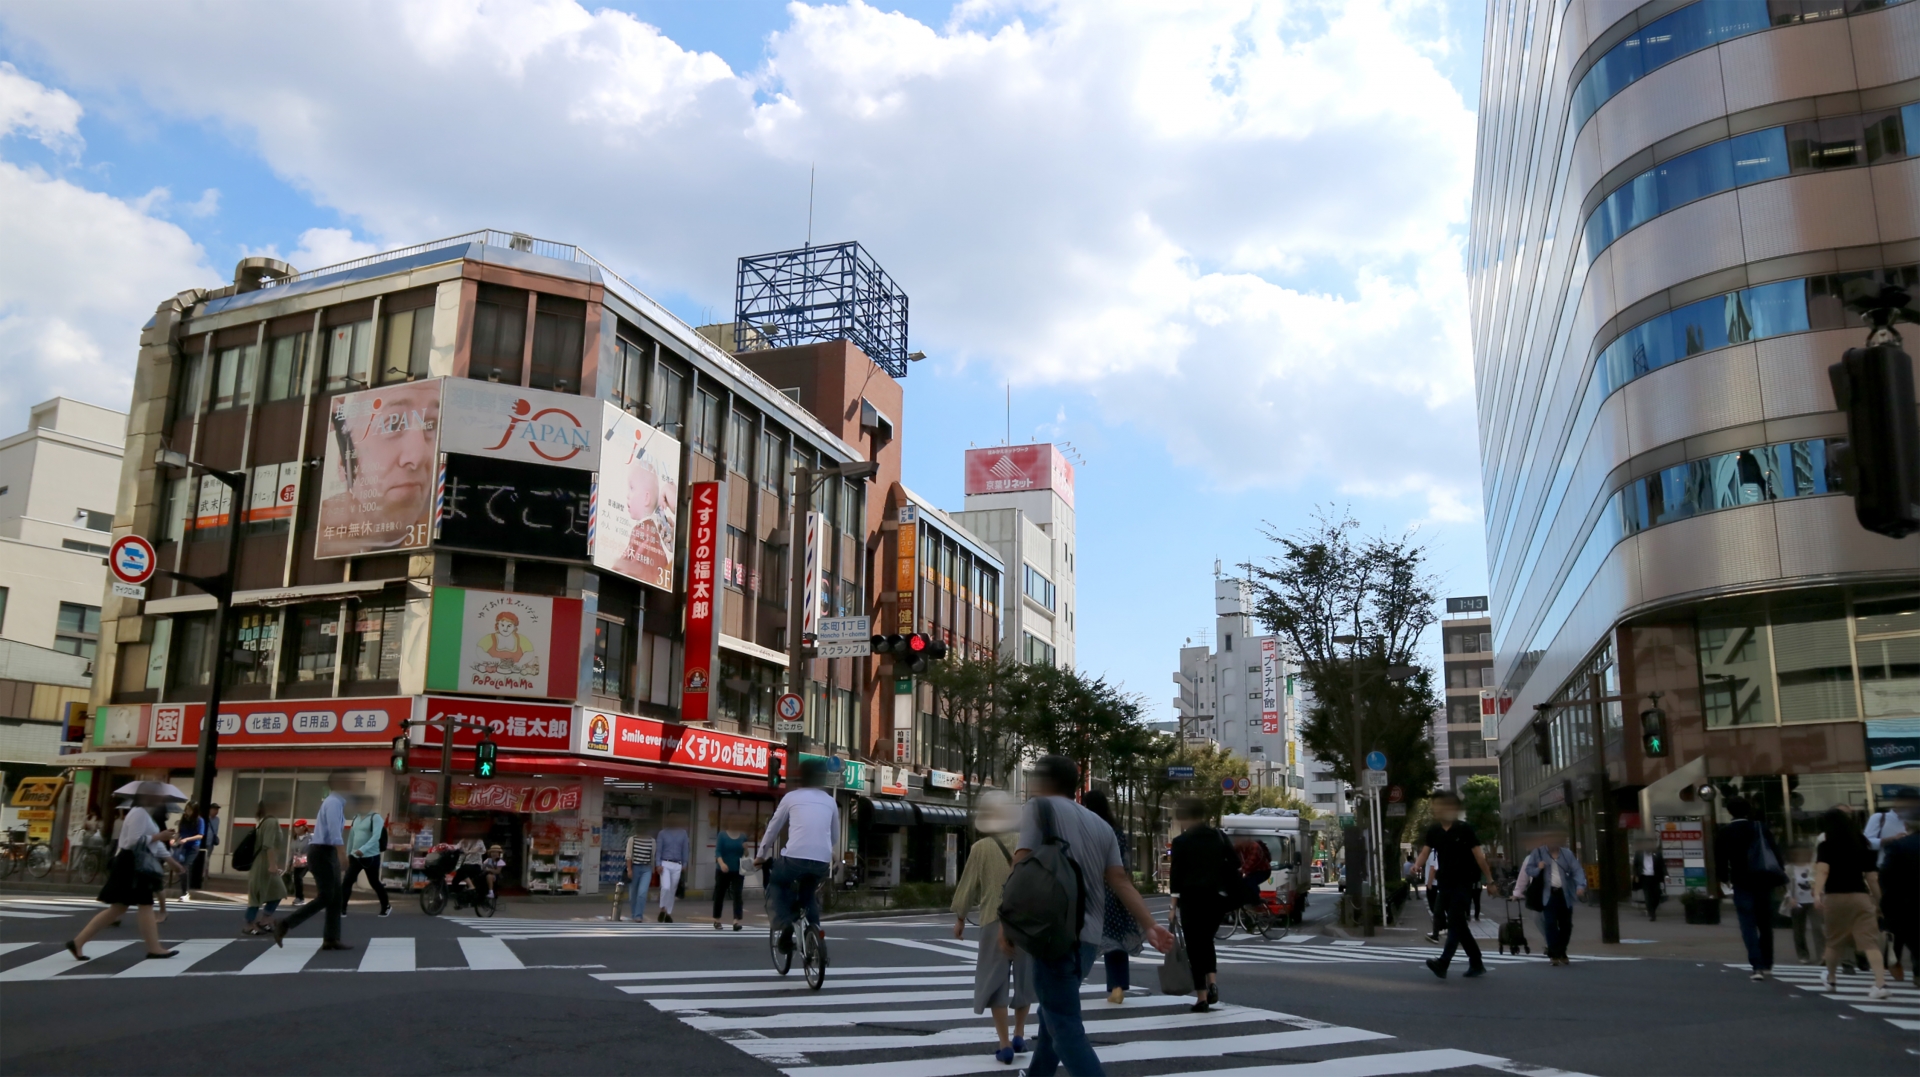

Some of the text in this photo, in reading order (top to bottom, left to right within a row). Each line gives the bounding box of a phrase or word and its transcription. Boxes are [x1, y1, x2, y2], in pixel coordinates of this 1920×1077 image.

[985, 477, 1034, 490] 京葉リネット
[323, 520, 373, 541] 年中無休
[404, 523, 427, 547] 3F
[691, 486, 714, 620] くすりの福太郎
[656, 566, 671, 588] 3F
[1460, 598, 1483, 610] 1:43
[820, 619, 866, 632] 本町1丁目
[821, 644, 867, 656] スクランブル
[1263, 653, 1275, 709] プラチナ館
[156, 710, 179, 741] 薬
[252, 716, 281, 730] 化粧品
[299, 715, 329, 729] 日用品
[354, 714, 376, 728] 食品
[429, 712, 567, 740] くすりの福太郎
[777, 723, 803, 731] ここから
[1263, 722, 1277, 732] 2F
[621, 729, 683, 752] Smile every day!
[685, 735, 767, 769] くすりの福太郎
[19, 788, 52, 803] Times
